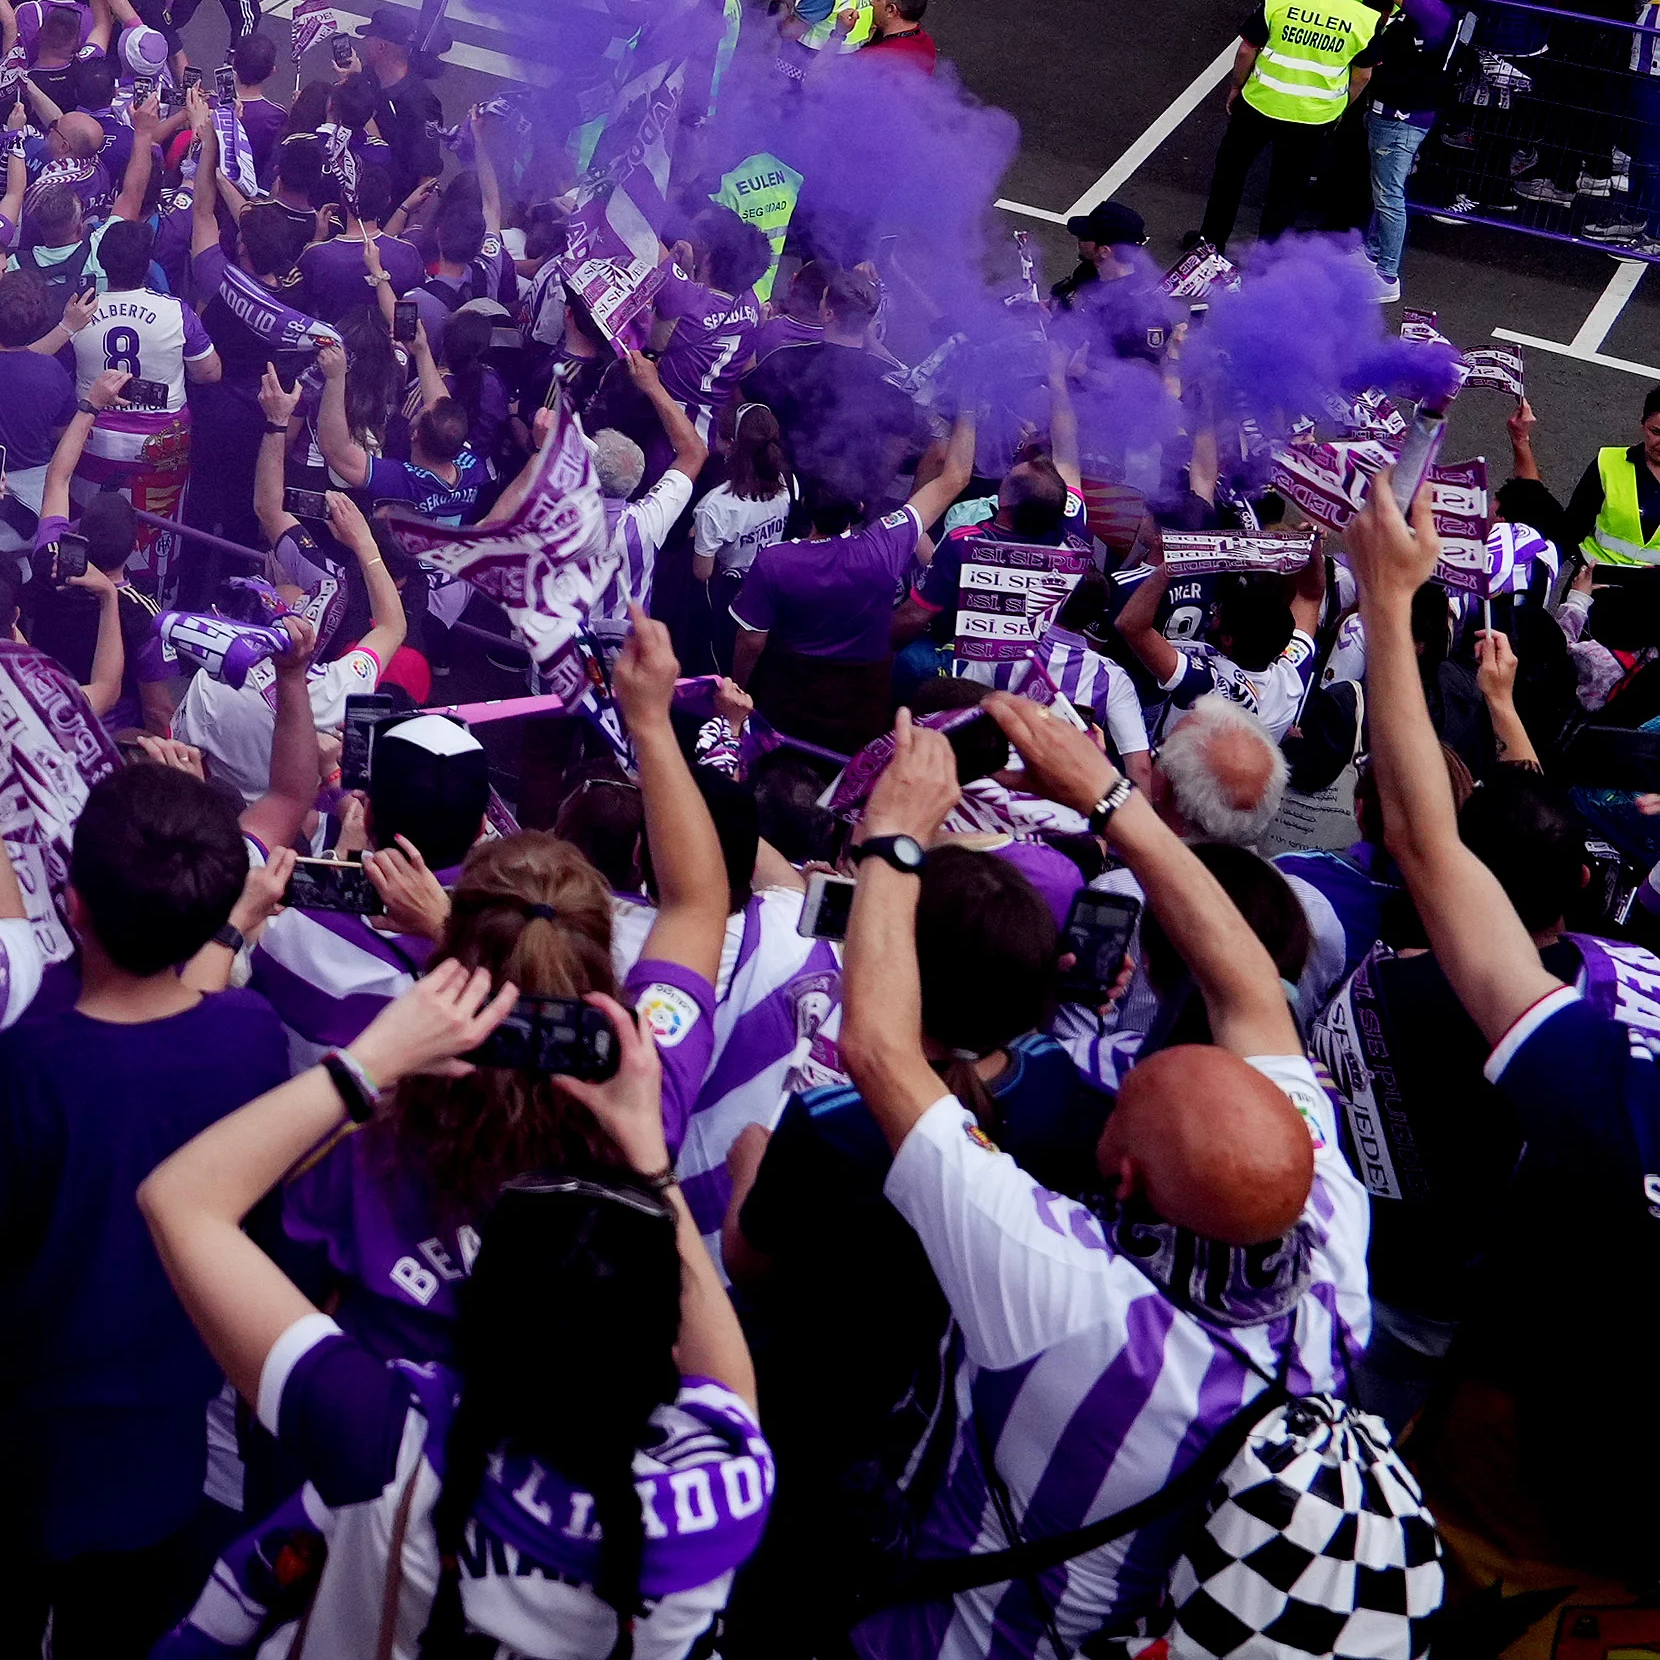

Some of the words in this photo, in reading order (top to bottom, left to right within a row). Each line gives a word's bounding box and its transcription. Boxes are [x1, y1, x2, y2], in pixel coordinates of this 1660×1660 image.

[1286, 5, 1352, 34] EULEN
[1281, 24, 1345, 54] SEGURIDAD
[735, 170, 786, 197] EULEN
[741, 199, 787, 221] SEGIDAD
[91, 303, 158, 326] ALBERTO
[102, 325, 141, 381] 8
[700, 335, 742, 392] 7
